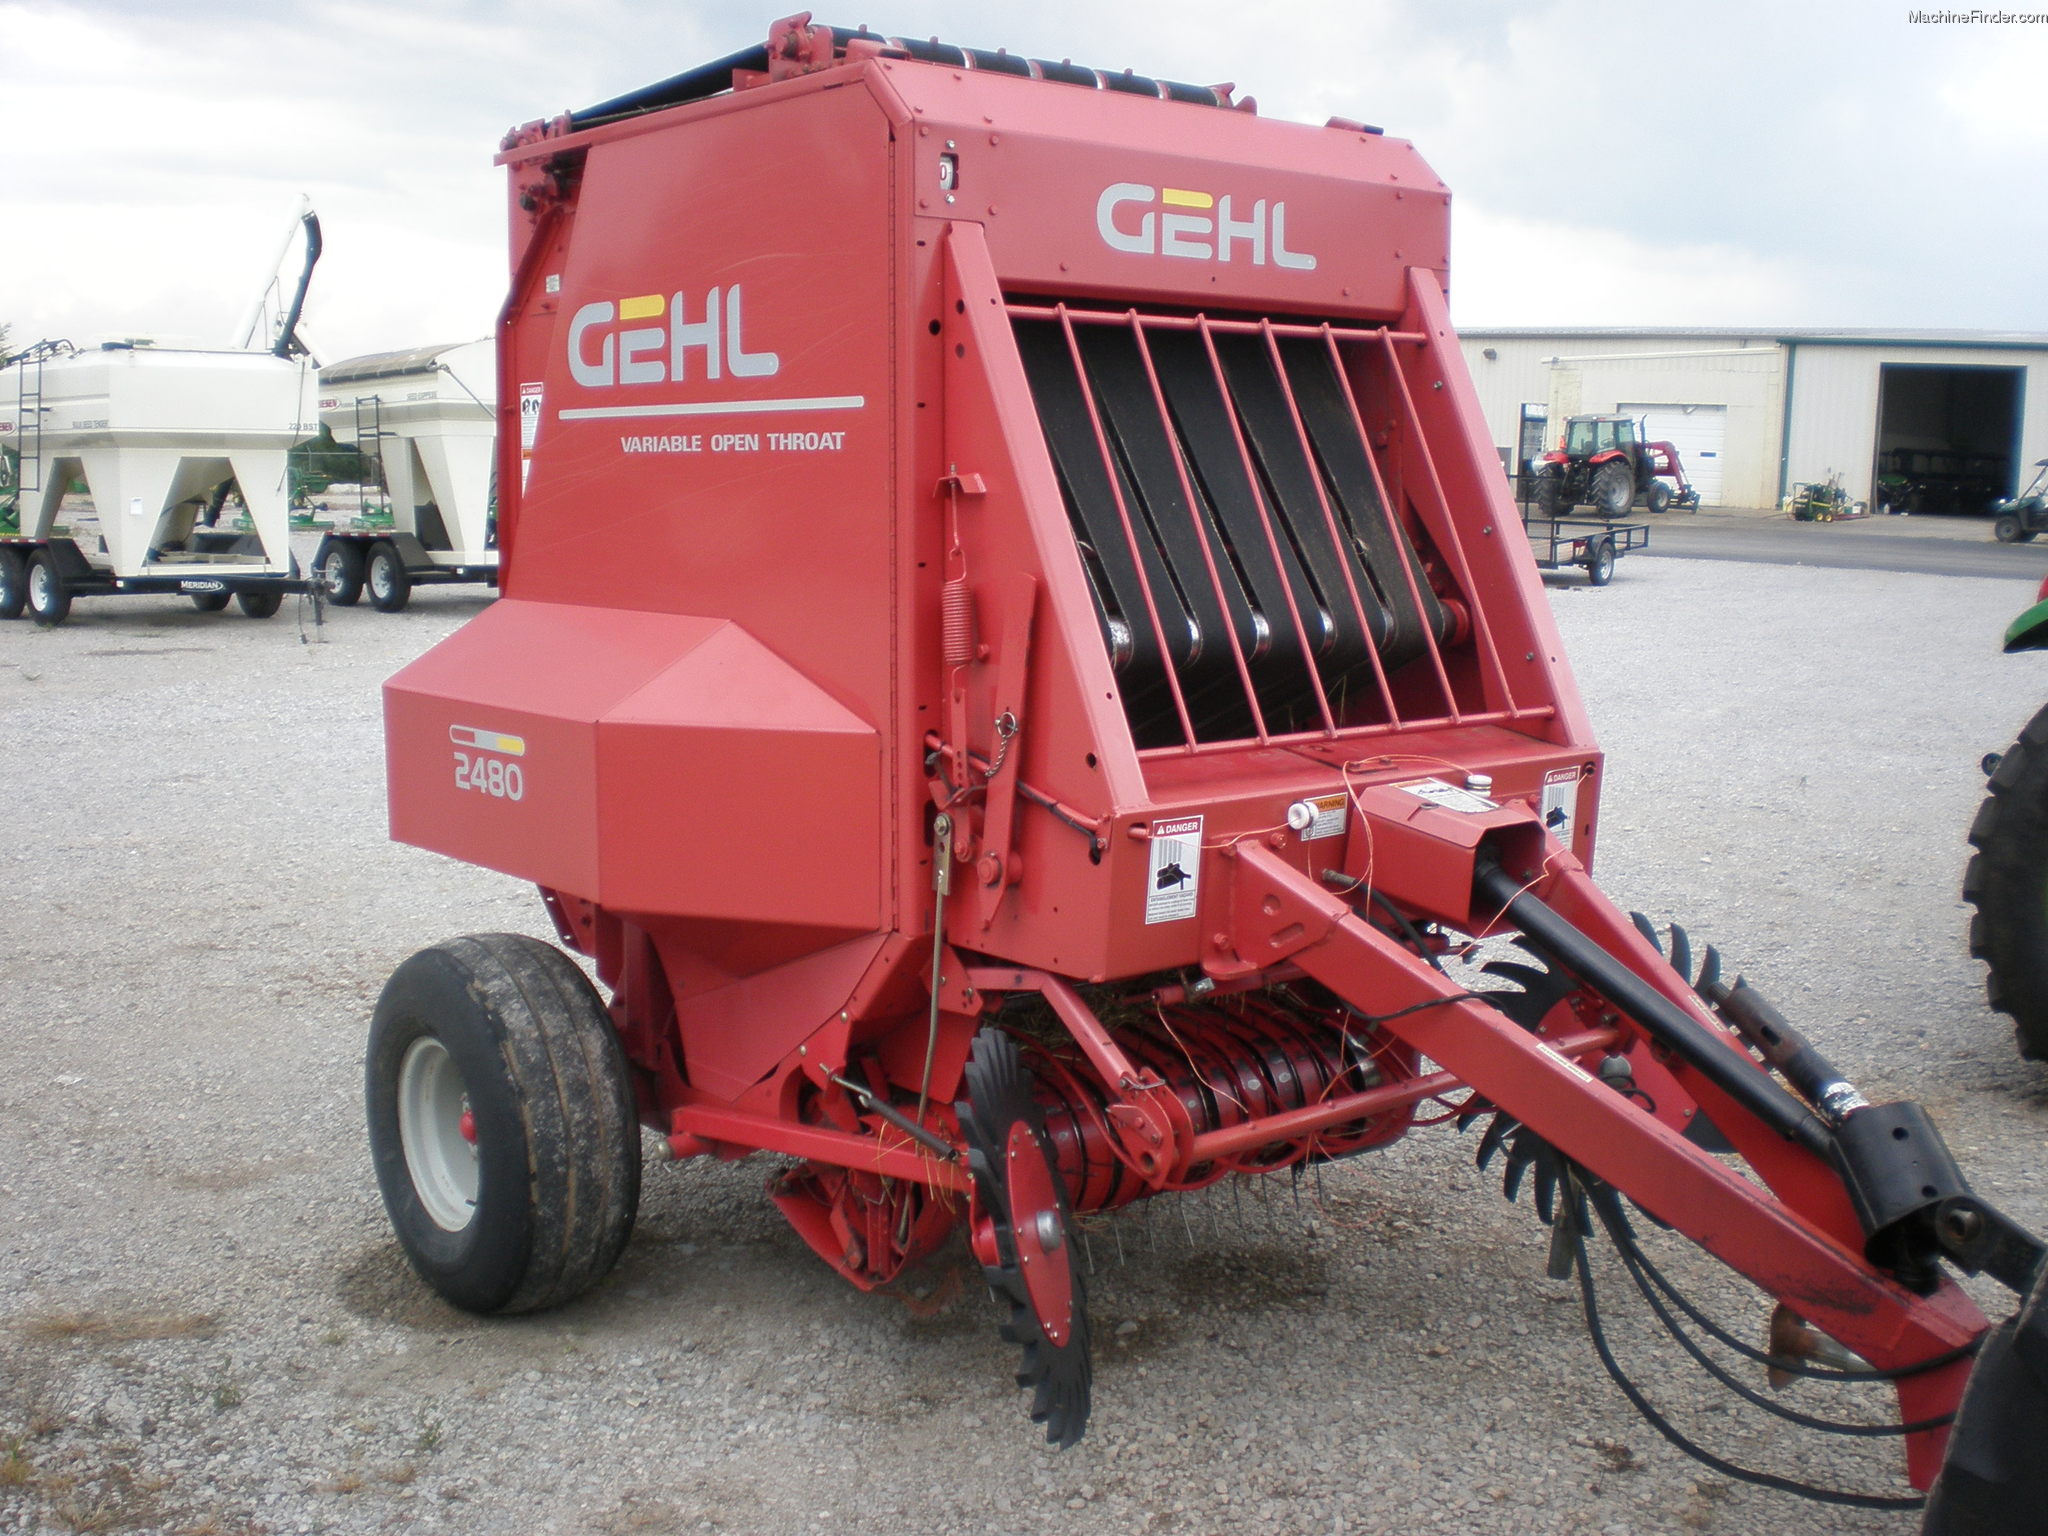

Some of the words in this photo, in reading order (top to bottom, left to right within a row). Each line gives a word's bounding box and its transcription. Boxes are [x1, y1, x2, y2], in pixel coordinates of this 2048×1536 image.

[1096, 182, 1317, 271] GEHL
[567, 283, 780, 388] GEHL
[620, 434, 702, 453] VARIABLE
[710, 433, 759, 451] OPEN
[766, 431, 846, 451] THROAT
[180, 580, 218, 589] MERIDIAN
[453, 751, 523, 801] 2480
[1553, 771, 1577, 781] DANGER
[1317, 798, 1345, 810] ARNING
[1165, 821, 1198, 834] DANGER
